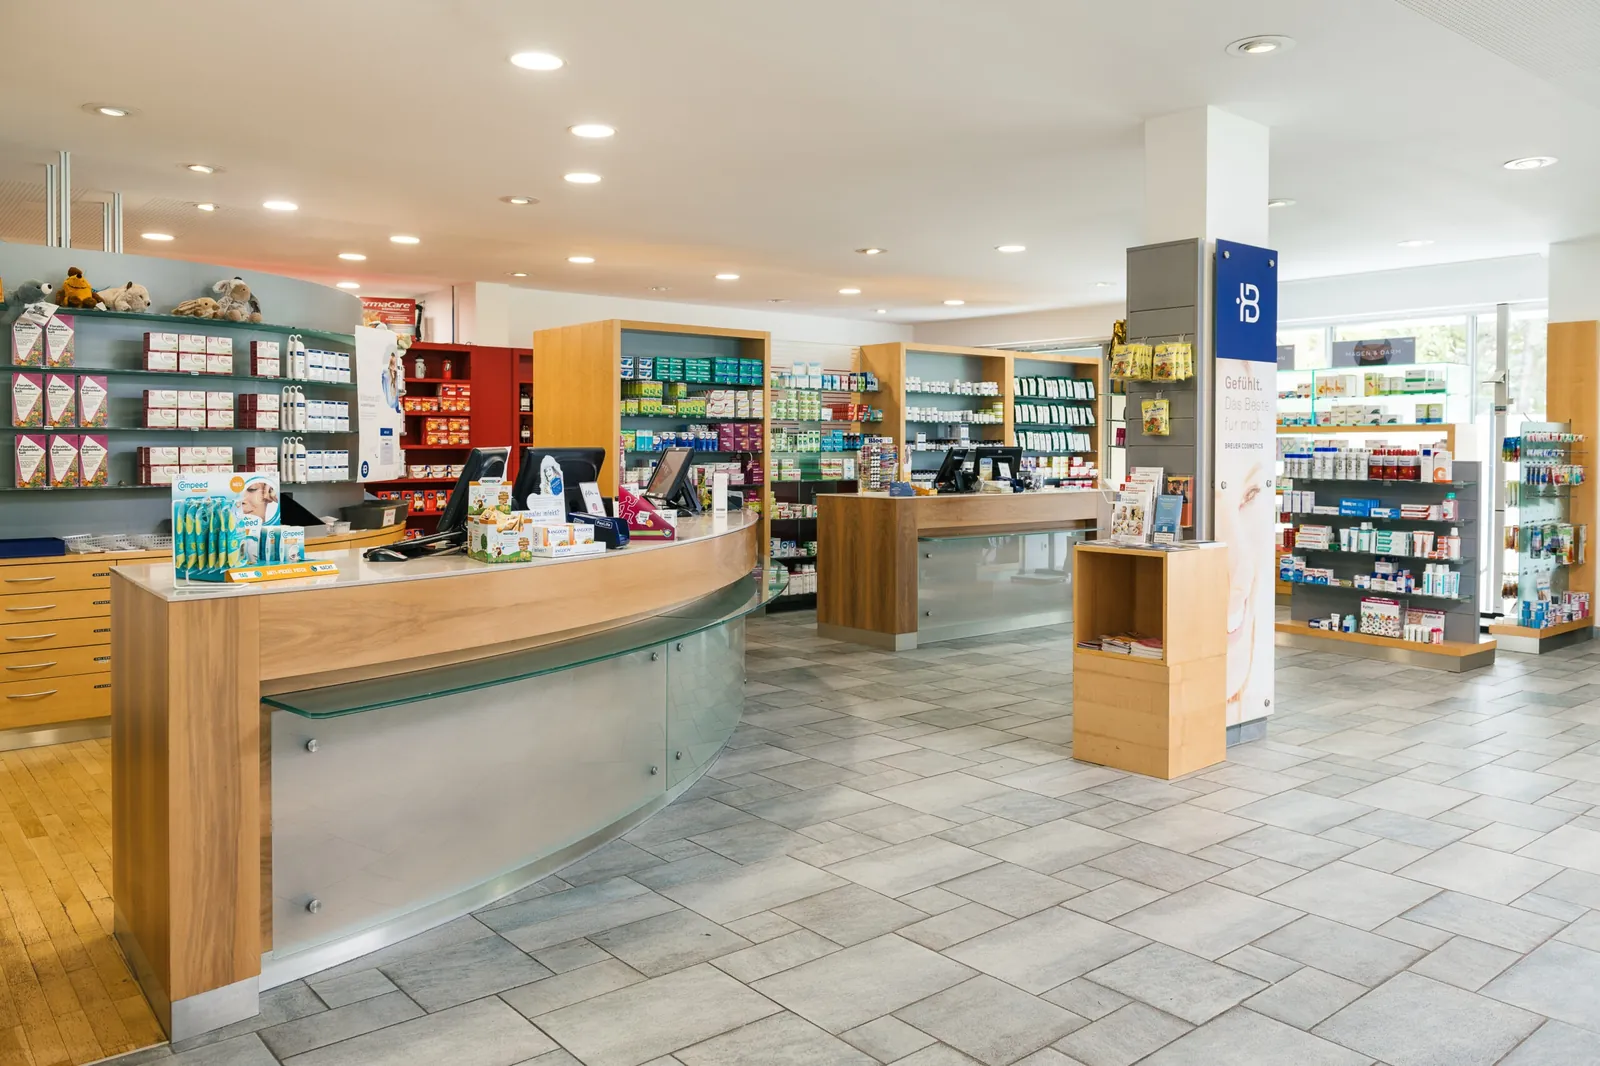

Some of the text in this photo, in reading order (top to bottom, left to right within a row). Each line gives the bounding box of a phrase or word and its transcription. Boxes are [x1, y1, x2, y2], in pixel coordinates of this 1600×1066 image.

[1225, 376, 1262, 391] Gefühlt.
[1225, 396, 1270, 412] Das Beste
[178, 480, 208, 491] Compeed
